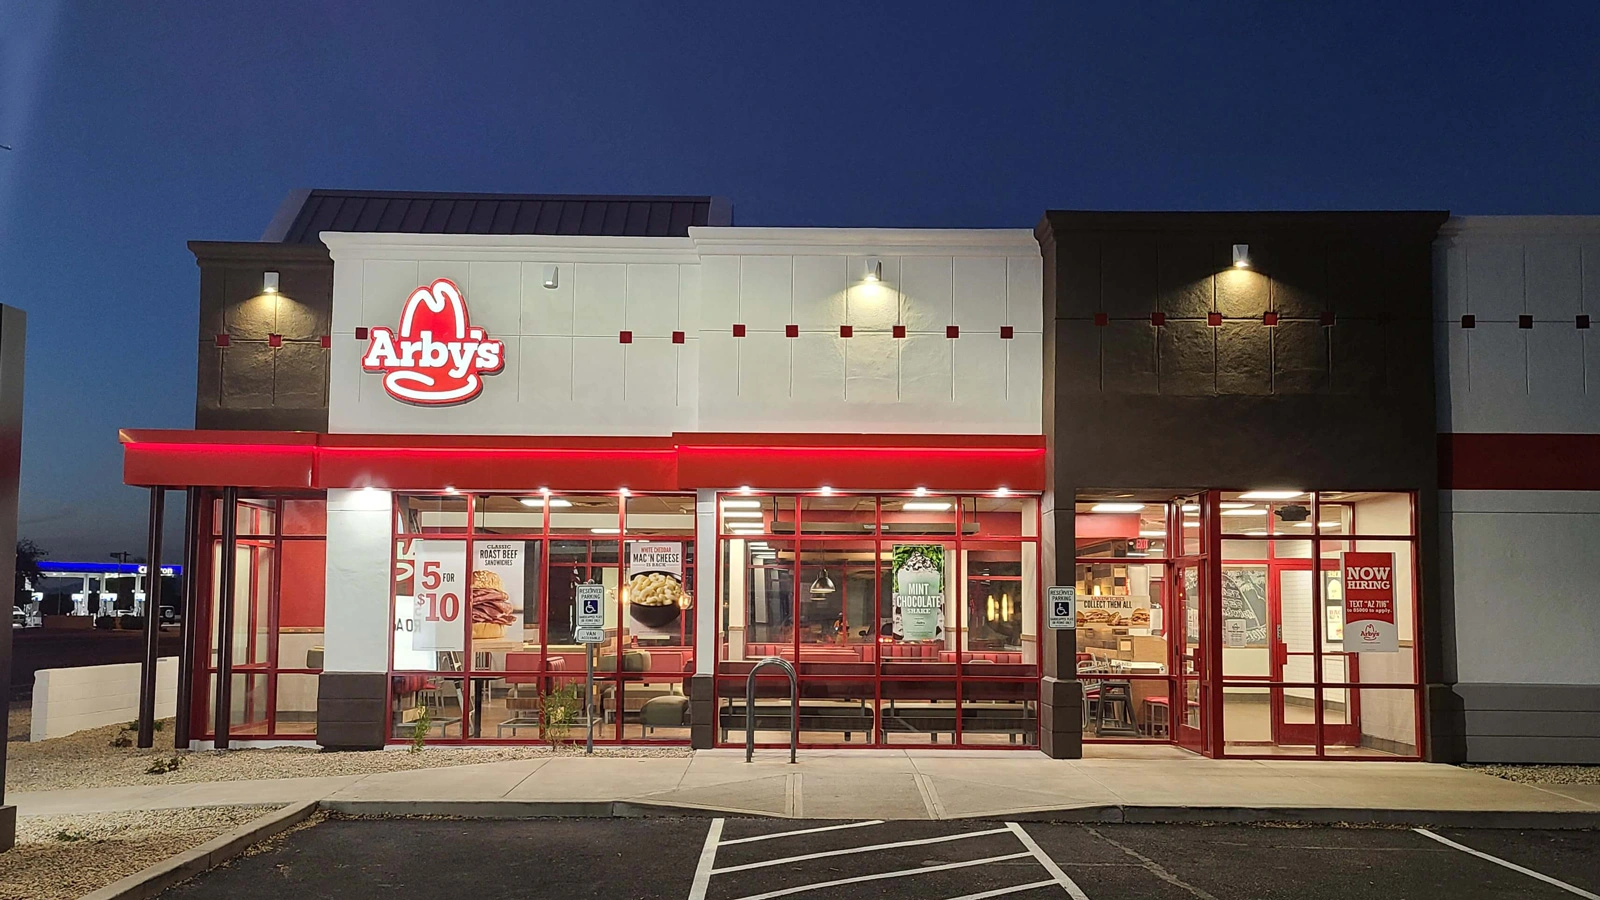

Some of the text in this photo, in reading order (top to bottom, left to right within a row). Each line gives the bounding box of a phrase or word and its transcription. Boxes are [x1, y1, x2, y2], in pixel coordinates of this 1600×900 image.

[364, 329, 500, 378] Arby's
[1136, 539, 1149, 549] EXIT
[480, 549, 518, 559] ROAST BEEF
[633, 553, 647, 563] MAC
[656, 553, 679, 563] CHEESE
[421, 561, 442, 590] 5
[443, 572, 455, 583] FOR
[1346, 566, 1391, 580] NOW
[908, 583, 929, 595] MINT
[1347, 580, 1390, 590] HIRING
[417, 592, 460, 622] $10
[896, 595, 940, 608] CHOCOLATE
[1084, 600, 1132, 609] COLLECT THEM ALL
[1349, 600, 1363, 608] TEXT
